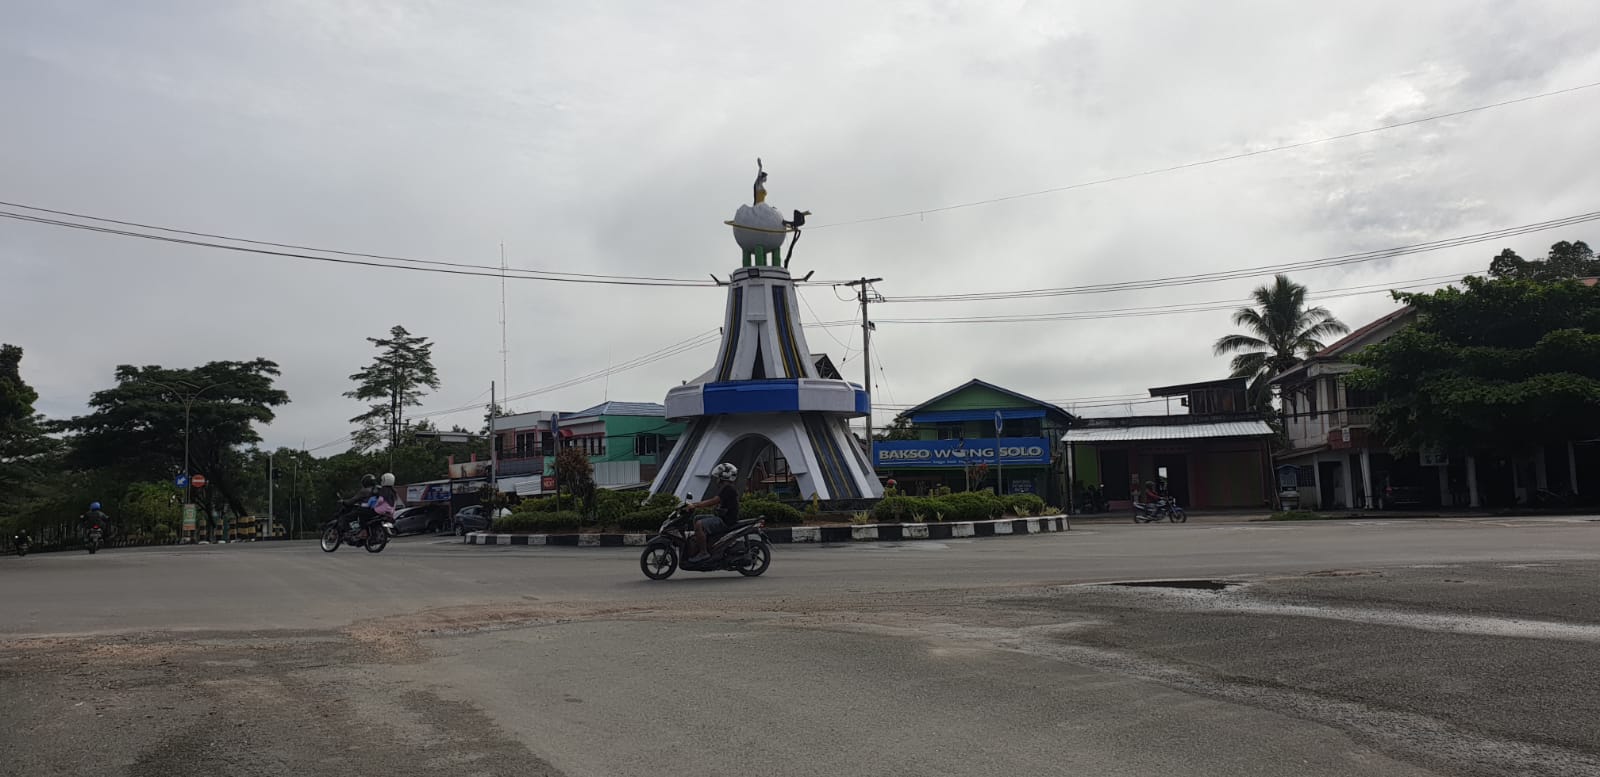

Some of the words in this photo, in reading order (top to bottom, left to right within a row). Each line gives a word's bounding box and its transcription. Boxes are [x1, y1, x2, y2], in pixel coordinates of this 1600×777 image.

[880, 449, 930, 459] BAKSO
[934, 448, 994, 458] WONG
[1000, 446, 1042, 457] SOLO
